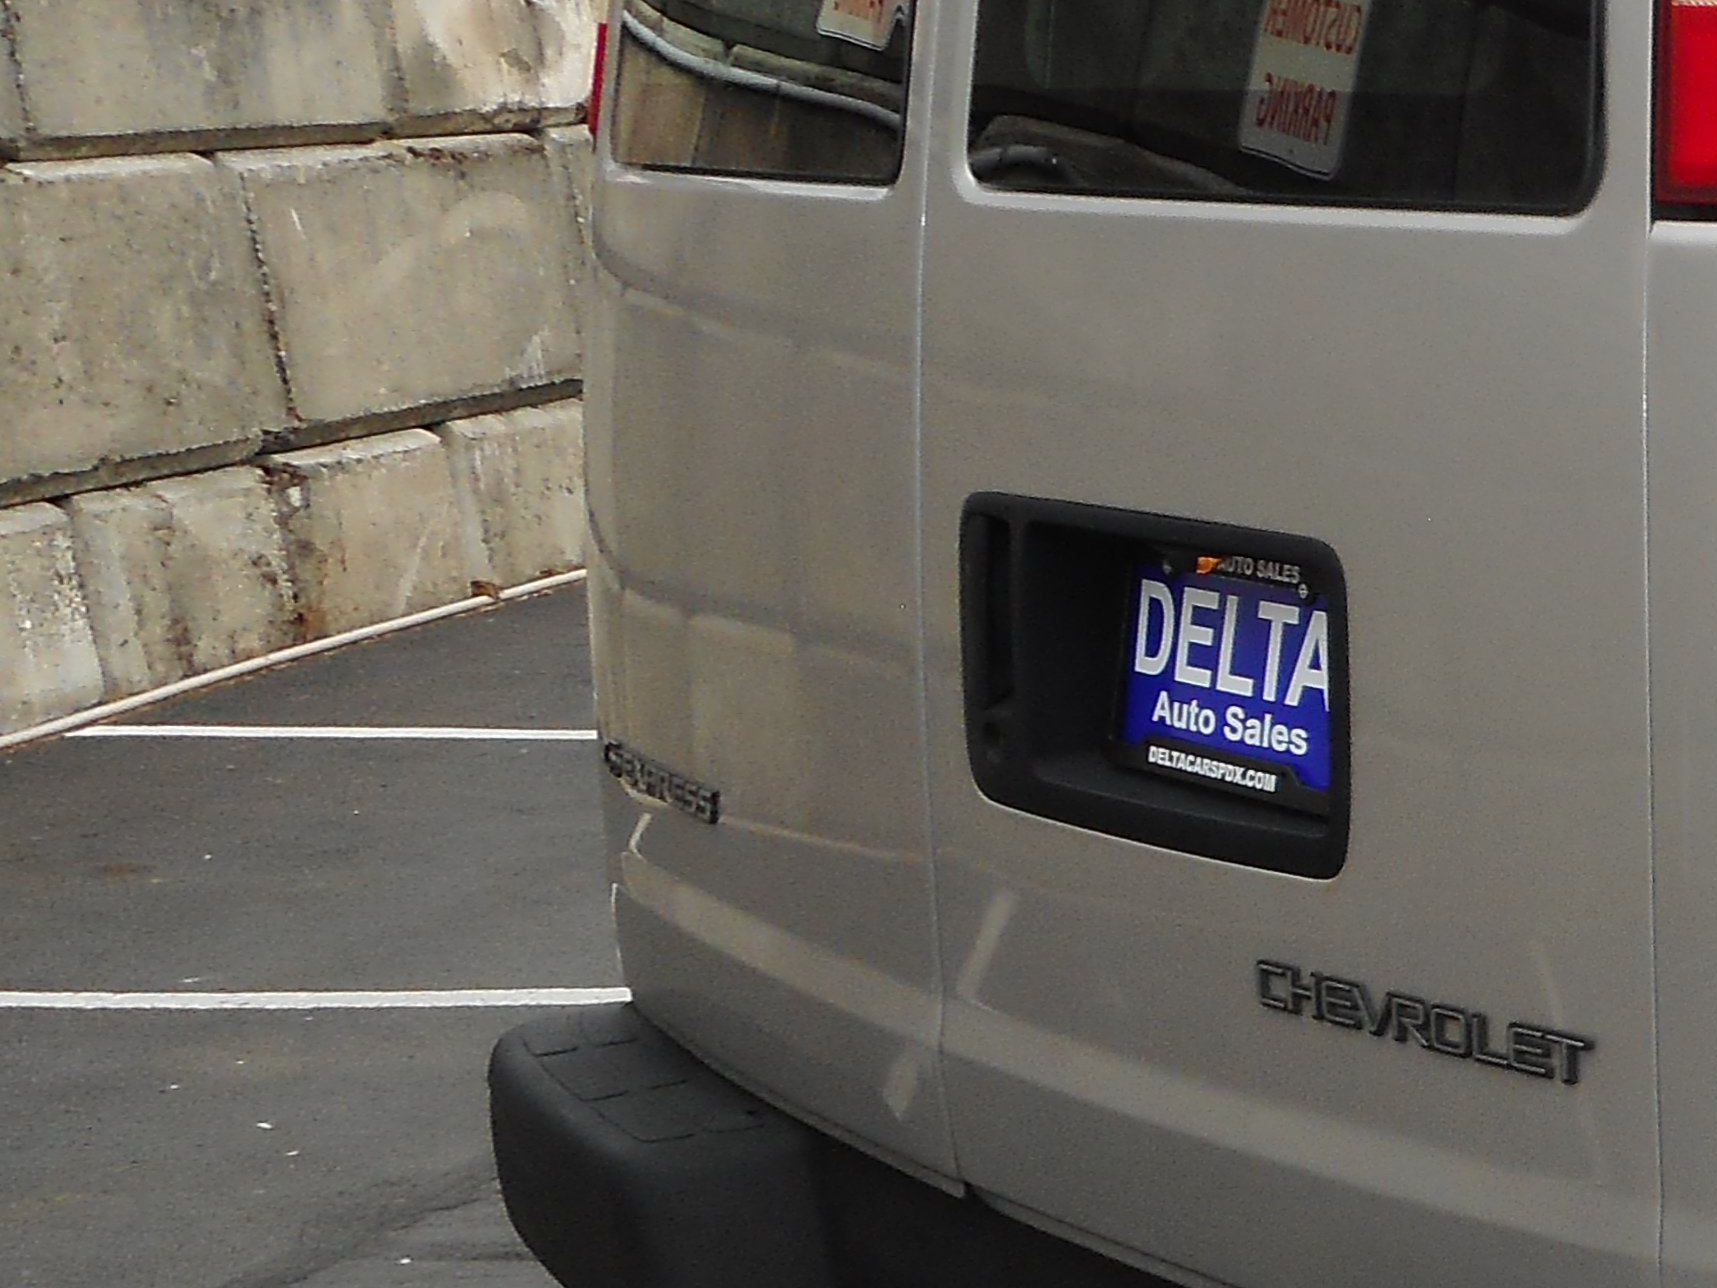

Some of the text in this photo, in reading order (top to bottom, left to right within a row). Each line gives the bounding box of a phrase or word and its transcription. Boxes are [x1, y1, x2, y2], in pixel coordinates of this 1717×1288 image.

[1216, 555, 1255, 576] AUTO
[1256, 559, 1301, 584] SALES
[1134, 578, 1330, 712] DELTA
[1151, 690, 1309, 756] Auto Sales
[1147, 745, 1278, 793] DELTACARSPDX.COM
[1256, 958, 1597, 1086] CHEVROLET
